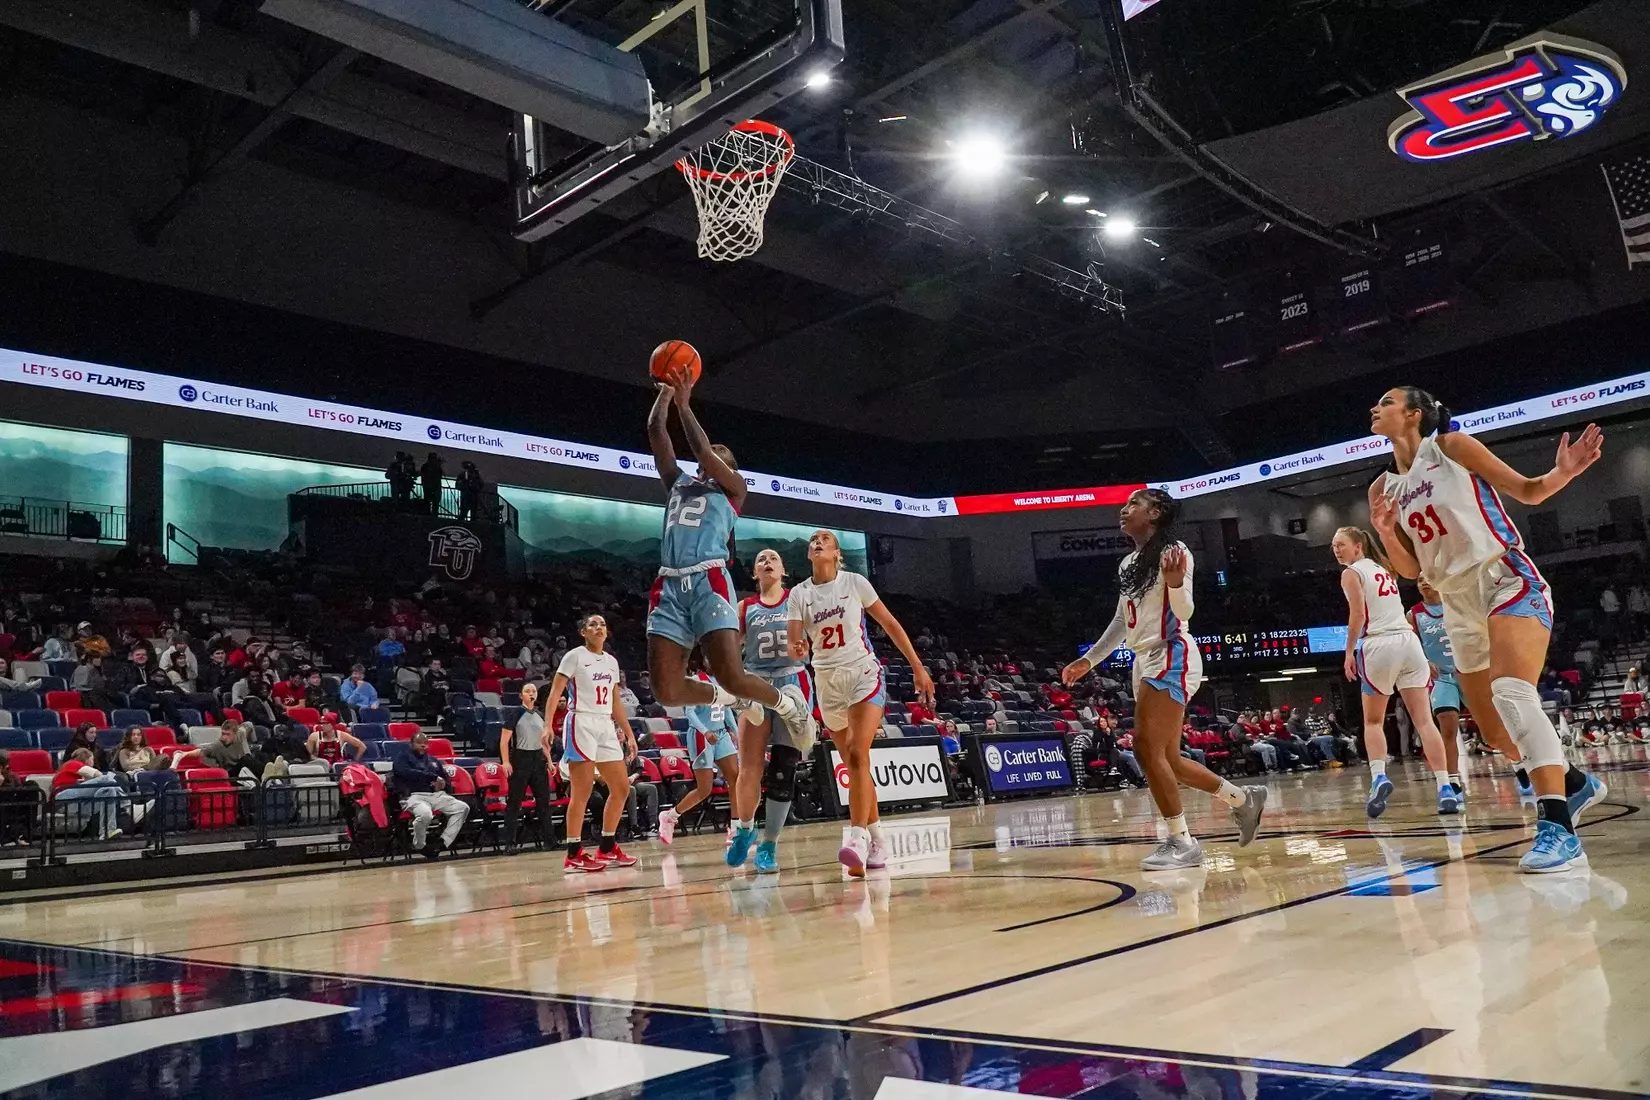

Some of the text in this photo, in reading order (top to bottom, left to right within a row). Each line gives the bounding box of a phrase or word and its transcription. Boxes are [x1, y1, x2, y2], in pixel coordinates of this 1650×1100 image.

[1344, 280, 1370, 297] 2019
[1280, 302, 1308, 320] 2023
[22, 363, 145, 391] LET'S GO FLAMES
[202, 391, 279, 412] Carter Bank
[1551, 380, 1646, 408] LET'S GO FLAMES
[308, 408, 402, 431] LET'S GO FLAMES
[1463, 407, 1526, 428] Carter Bank
[445, 430, 504, 448] Carter Bank
[1345, 443, 1368, 454] LET'S
[1369, 440, 1382, 449] GO
[526, 443, 599, 462] LET'S GO FLAMES
[632, 459, 656, 471] Carte
[1273, 453, 1325, 472] Carter Bank
[1196, 480, 1207, 489] GO
[1208, 472, 1240, 486] FLAMES
[782, 483, 820, 497] Carter Bank
[834, 491, 849, 500] LET'S
[859, 495, 882, 506] FLAMES
[903, 502, 921, 512] Carter
[1014, 496, 1042, 506] WELCOME
[1051, 494, 1074, 503] LIBERTY
[1075, 493, 1096, 502] ARENA
[666, 495, 707, 530] 22
[1408, 504, 1448, 543] 31
[1374, 572, 1398, 597] 23
[813, 605, 845, 624] Liberty
[821, 624, 846, 649] 21
[1202, 636, 1211, 644] 23
[1212, 635, 1221, 643] 31
[1225, 633, 1247, 644] 6:41
[1270, 631, 1279, 639] 18
[1279, 630, 1288, 638] 22
[1289, 629, 1298, 637] 23
[1298, 629, 1308, 637] 25
[757, 630, 787, 659] 25
[1262, 649, 1271, 657] 17
[1293, 647, 1299, 655] 3
[1303, 646, 1308, 654] 0
[1116, 650, 1131, 661] 48
[592, 672, 612, 684] Liberty
[595, 685, 608, 705] 12
[1003, 746, 1066, 765] Carter Bank
[870, 760, 942, 787] utova
[1006, 770, 1062, 783] LIFE LIVED FULL
